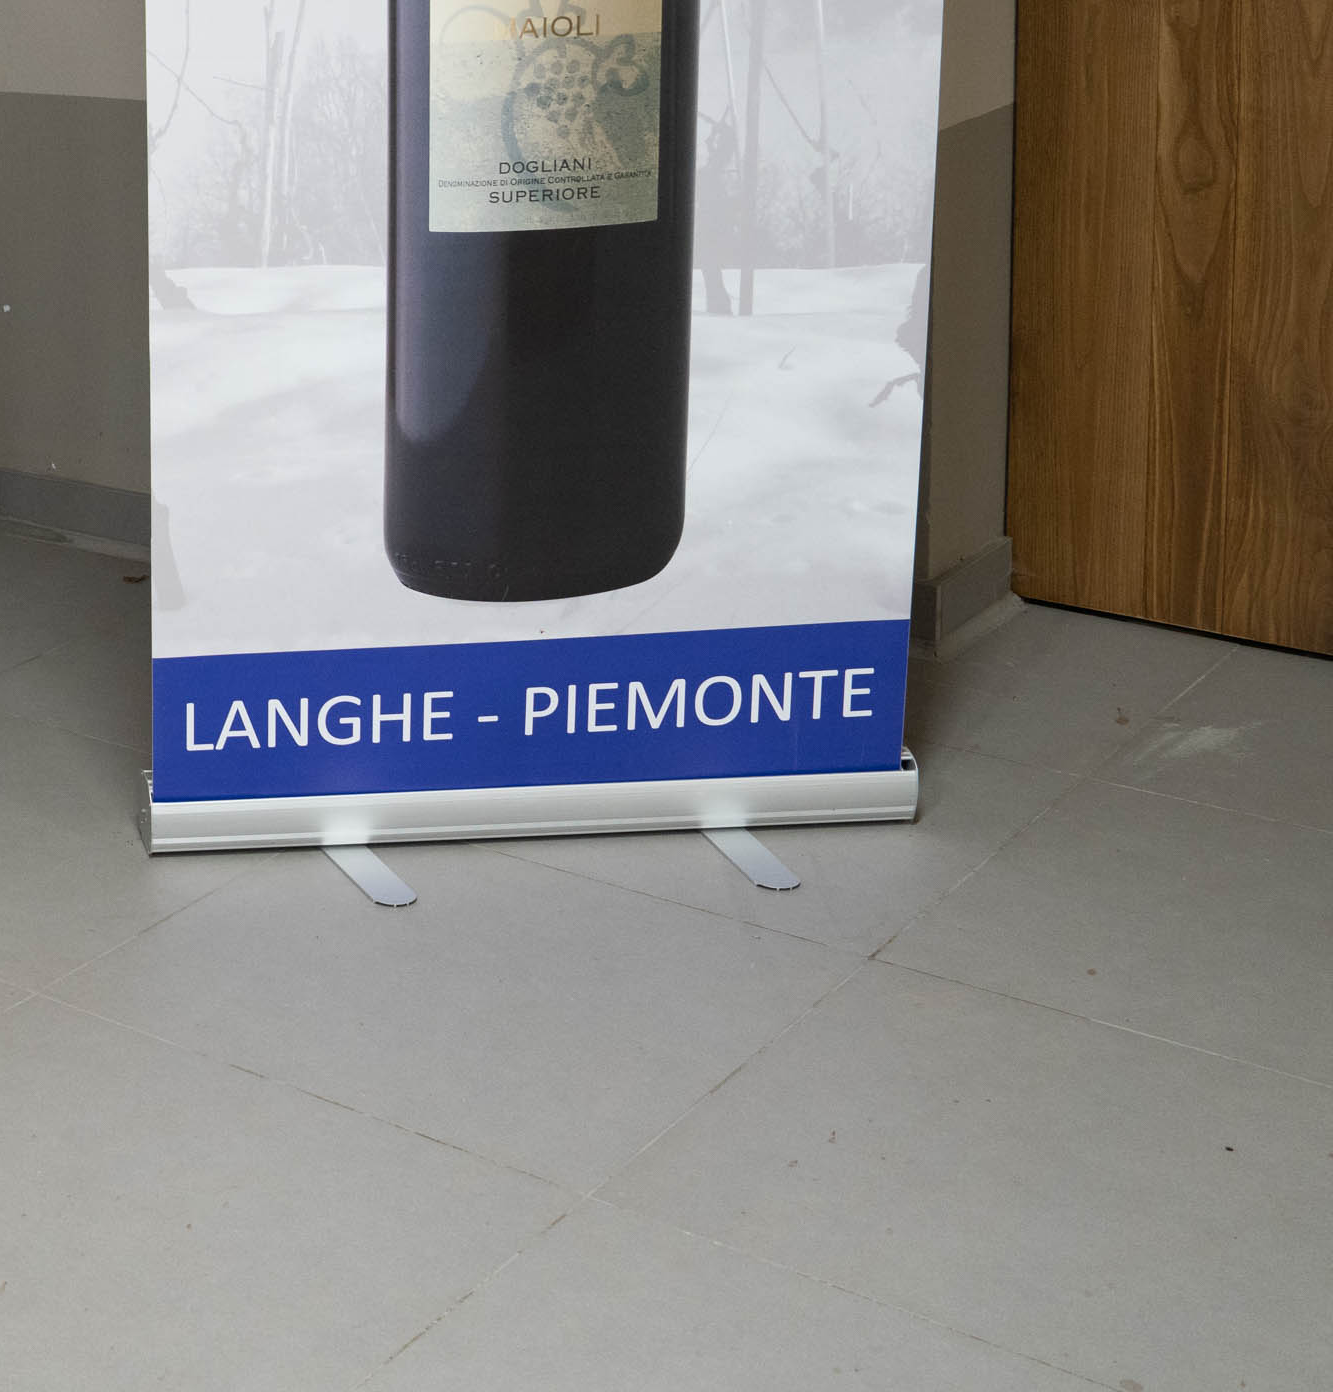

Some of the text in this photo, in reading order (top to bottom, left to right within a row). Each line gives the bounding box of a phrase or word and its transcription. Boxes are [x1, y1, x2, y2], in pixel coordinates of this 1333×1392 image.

[499, 158, 592, 175] DOGLIANI
[510, 177, 546, 186] ORIGINE
[547, 174, 605, 184] CONTROLLATA
[489, 186, 601, 204] SUPERIORE
[185, 690, 455, 752] LANGHE
[524, 667, 876, 736] PIEMONTE
